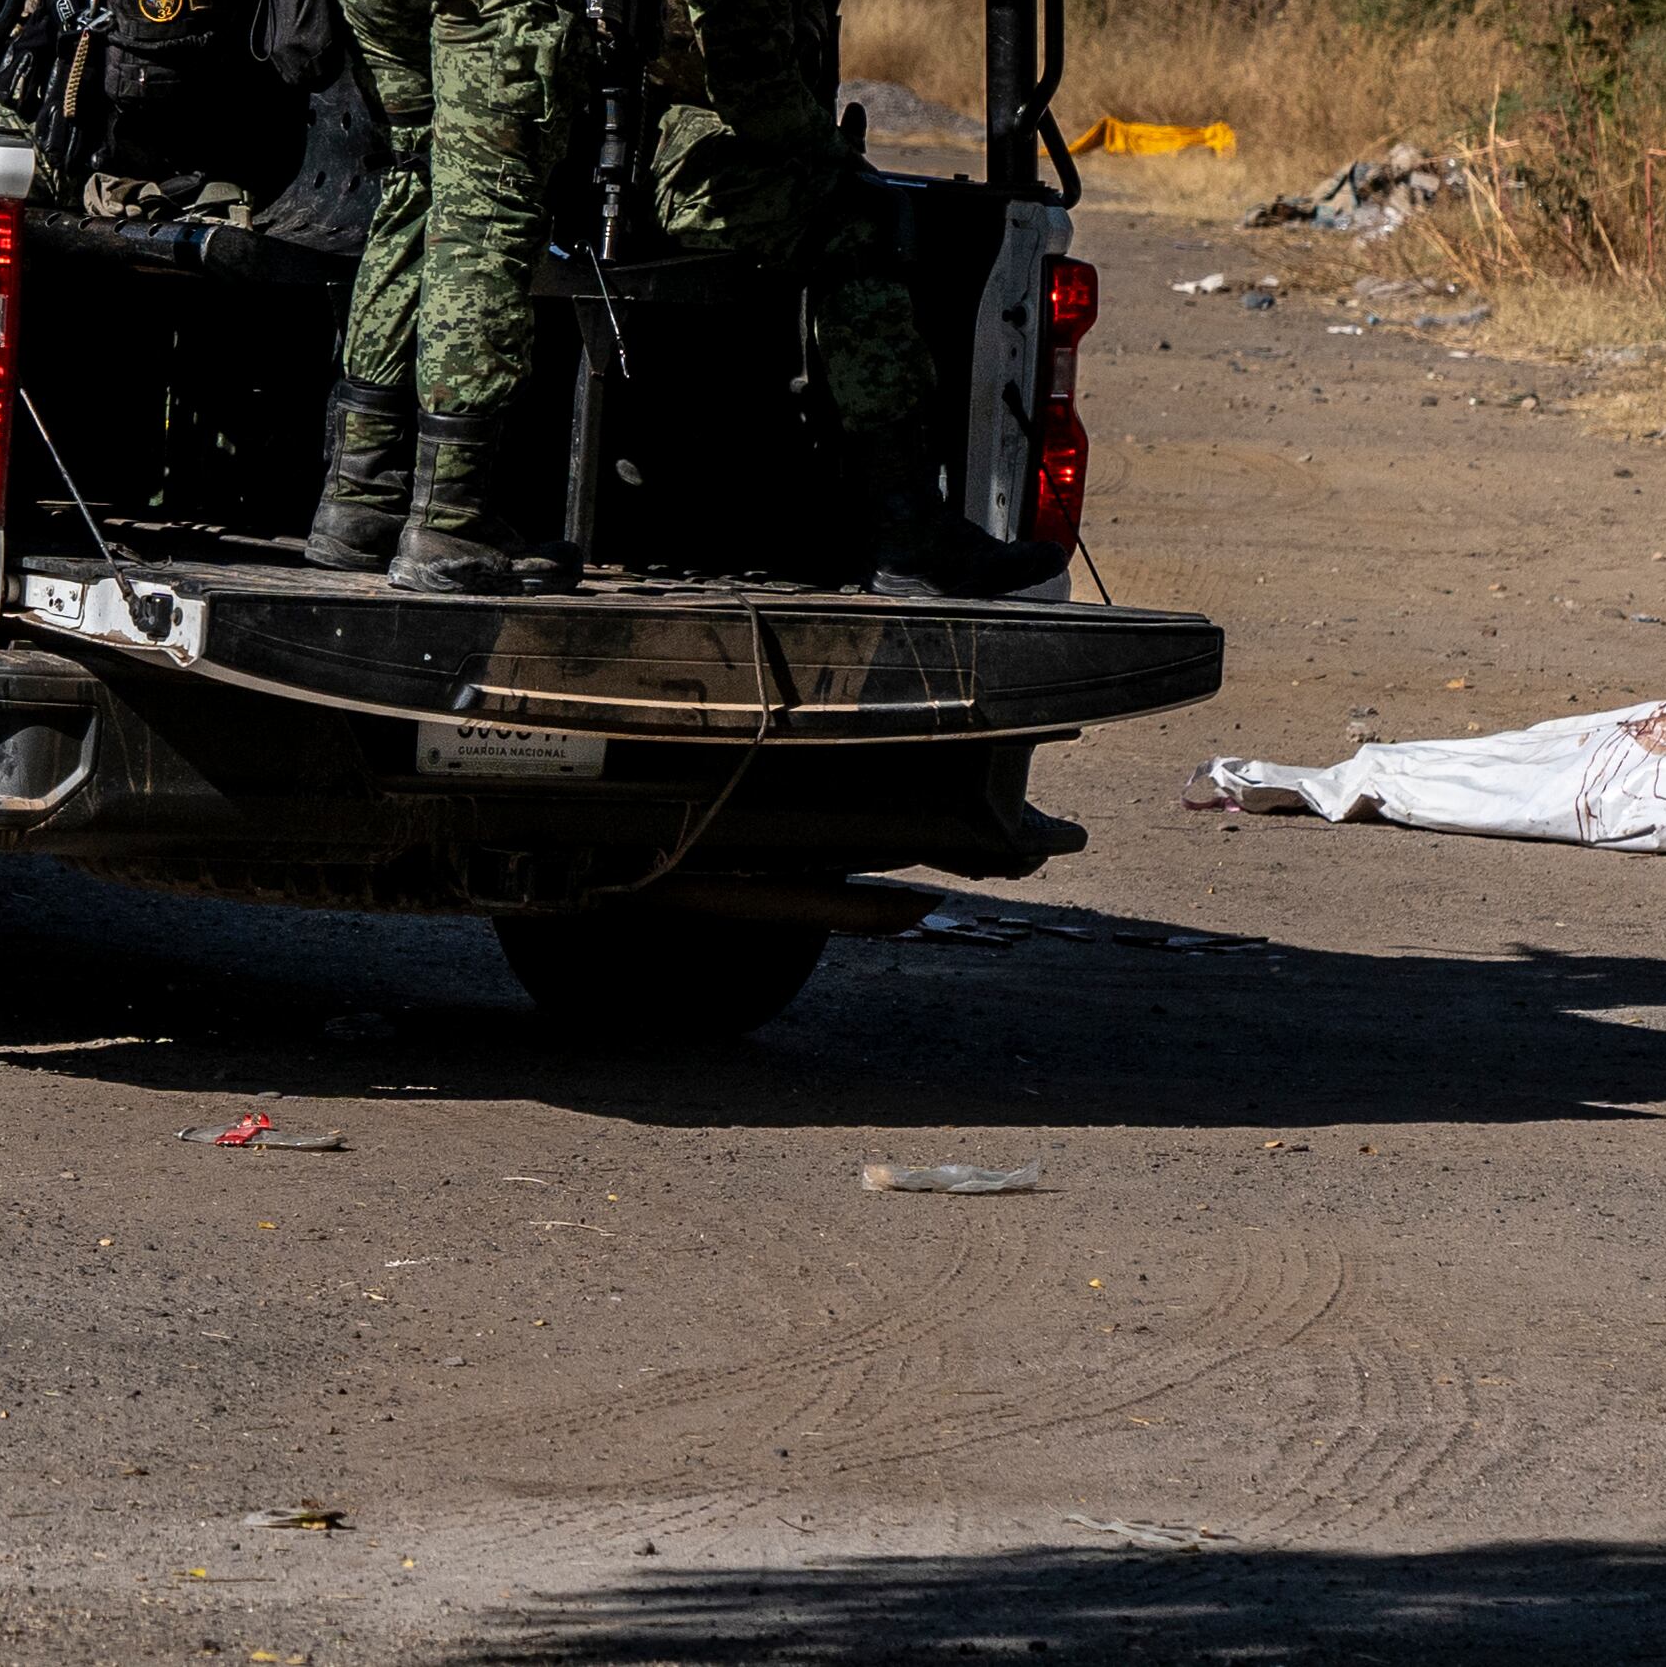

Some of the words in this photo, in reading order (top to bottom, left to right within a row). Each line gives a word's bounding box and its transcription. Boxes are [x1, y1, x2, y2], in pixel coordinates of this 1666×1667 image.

[157, 7, 173, 19] 32
[458, 745, 508, 757] GUARDIA
[510, 746, 567, 759] NACIONAL
